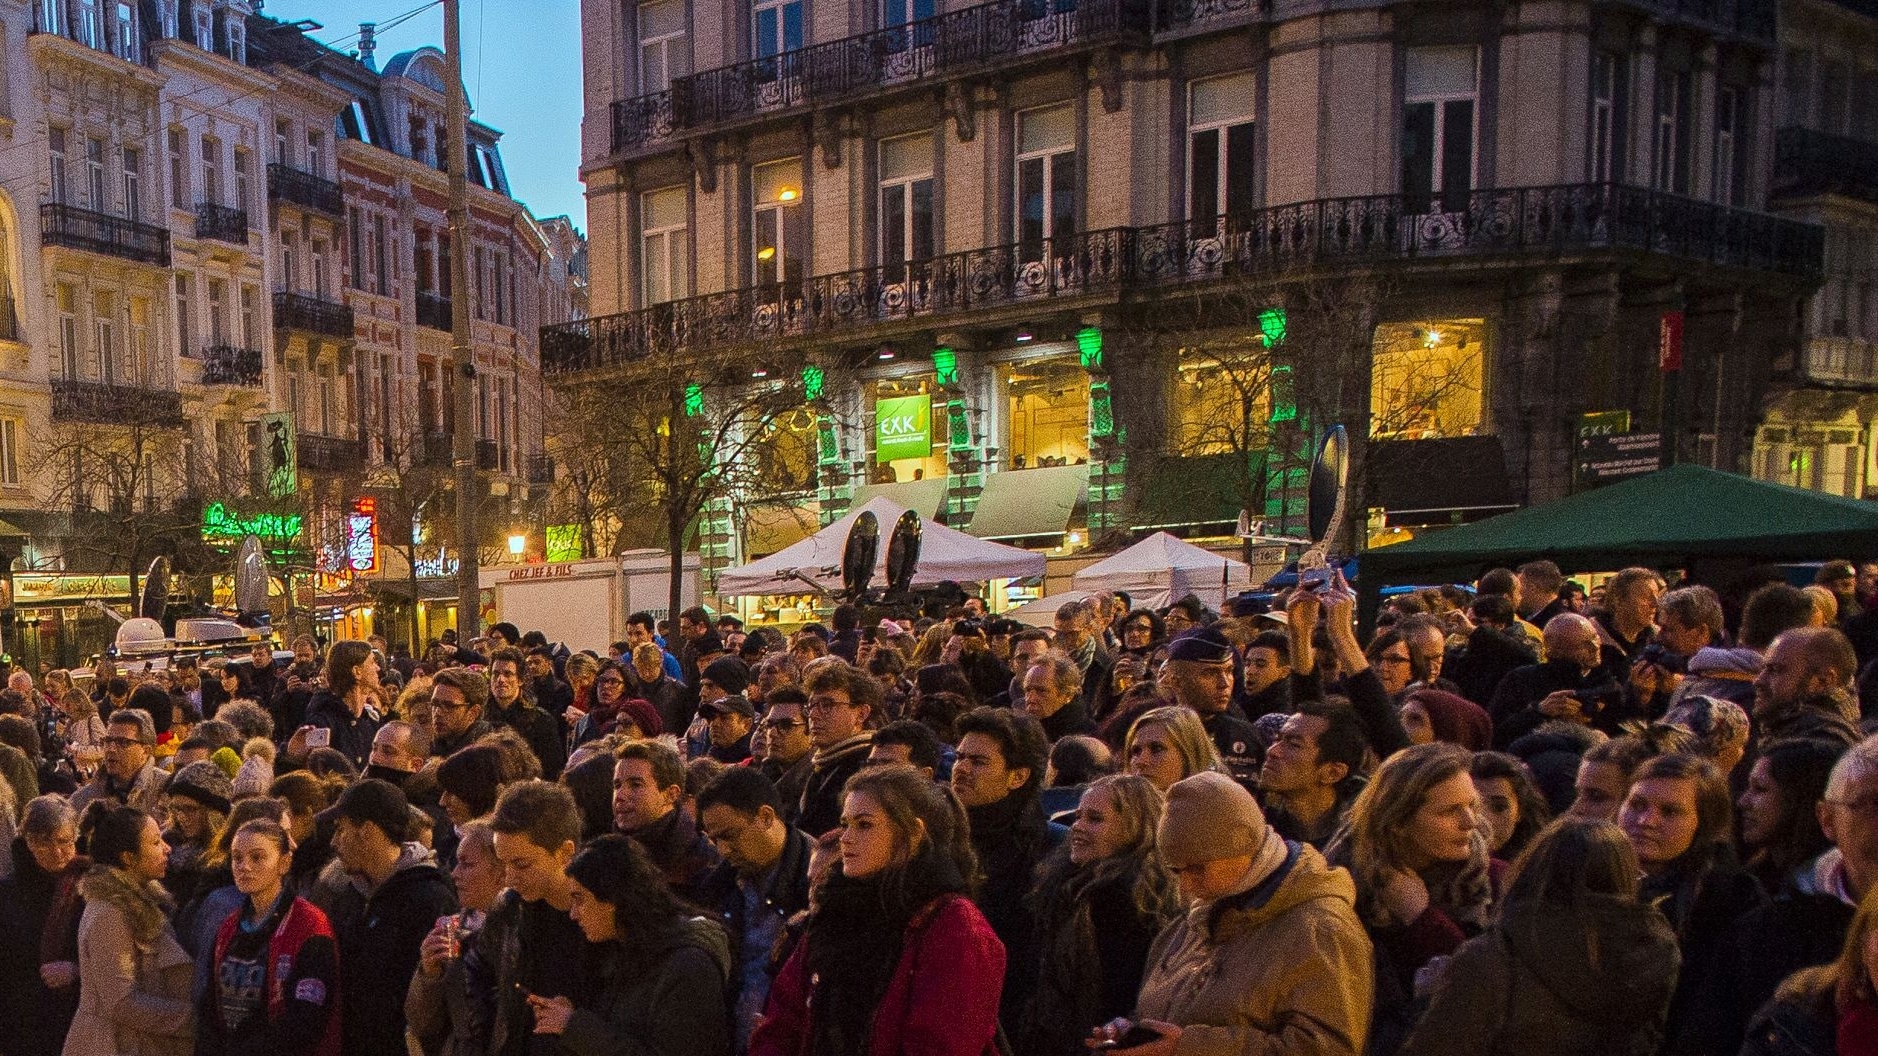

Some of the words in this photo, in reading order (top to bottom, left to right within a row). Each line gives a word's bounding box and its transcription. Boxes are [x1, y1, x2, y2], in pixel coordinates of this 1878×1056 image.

[509, 569, 529, 581] CHEZ
[545, 566, 553, 578] &
[554, 564, 572, 577] FILS
